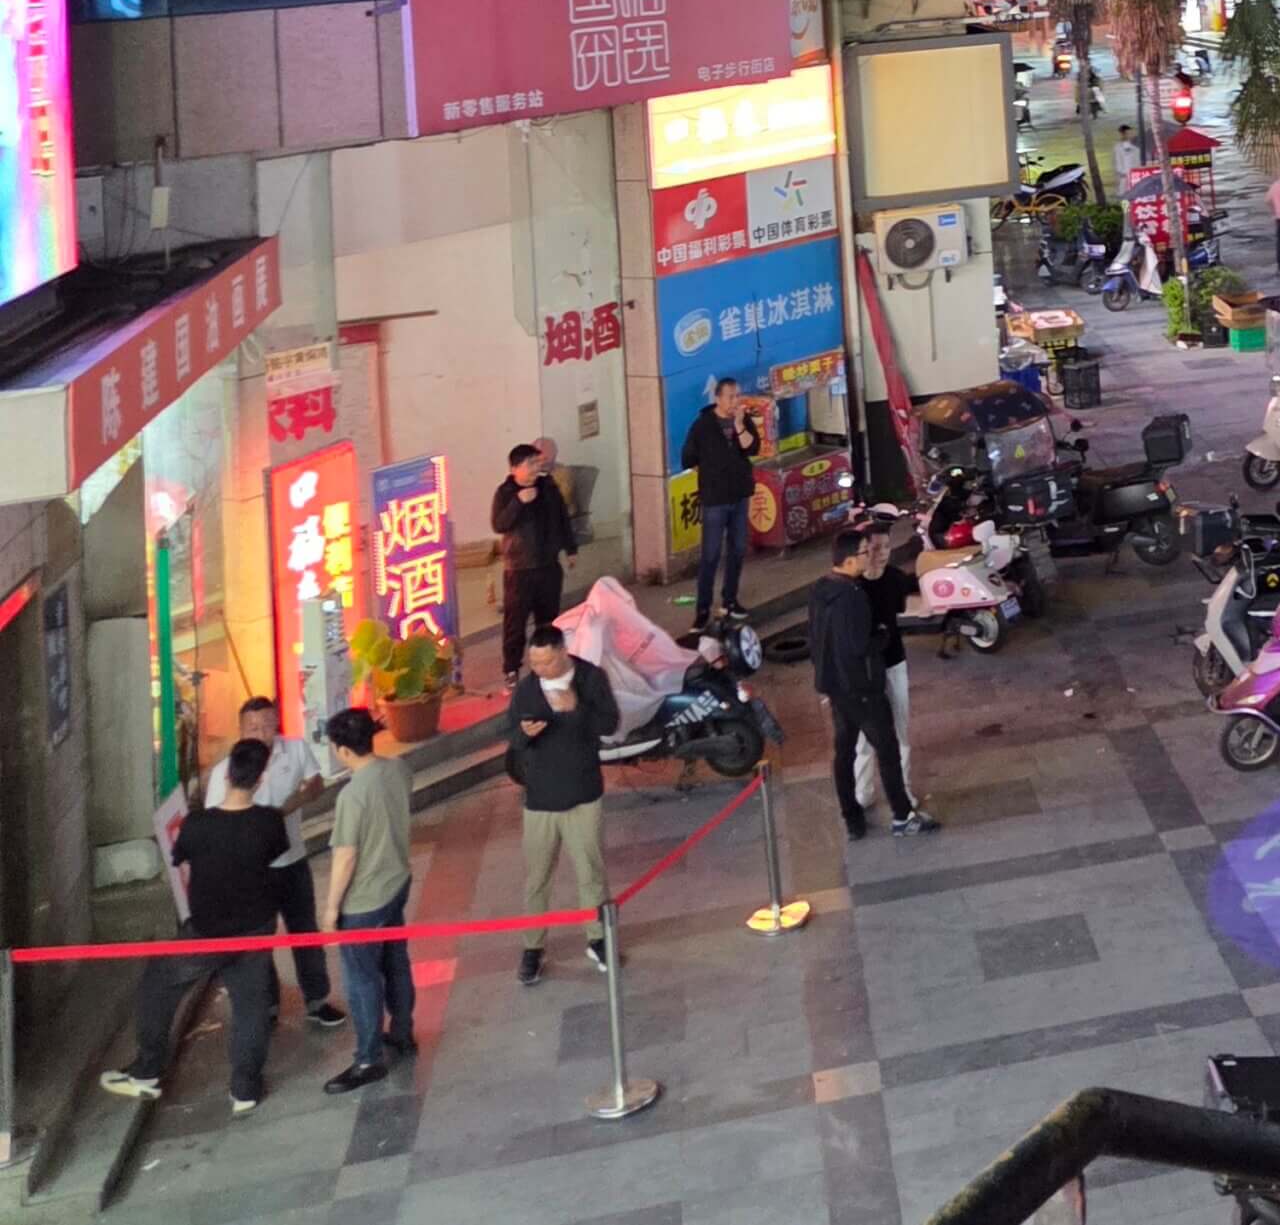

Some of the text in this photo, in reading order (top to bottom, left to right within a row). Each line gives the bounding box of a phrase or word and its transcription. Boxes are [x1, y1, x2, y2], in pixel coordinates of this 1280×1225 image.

[442, 90, 545, 122] 新零售服务站
[751, 208, 834, 245] 中国体育彩票
[656, 228, 747, 267] 中国福利彩票
[718, 283, 834, 340] 雀巢冰淇淋
[542, 301, 623, 367] 烟酒
